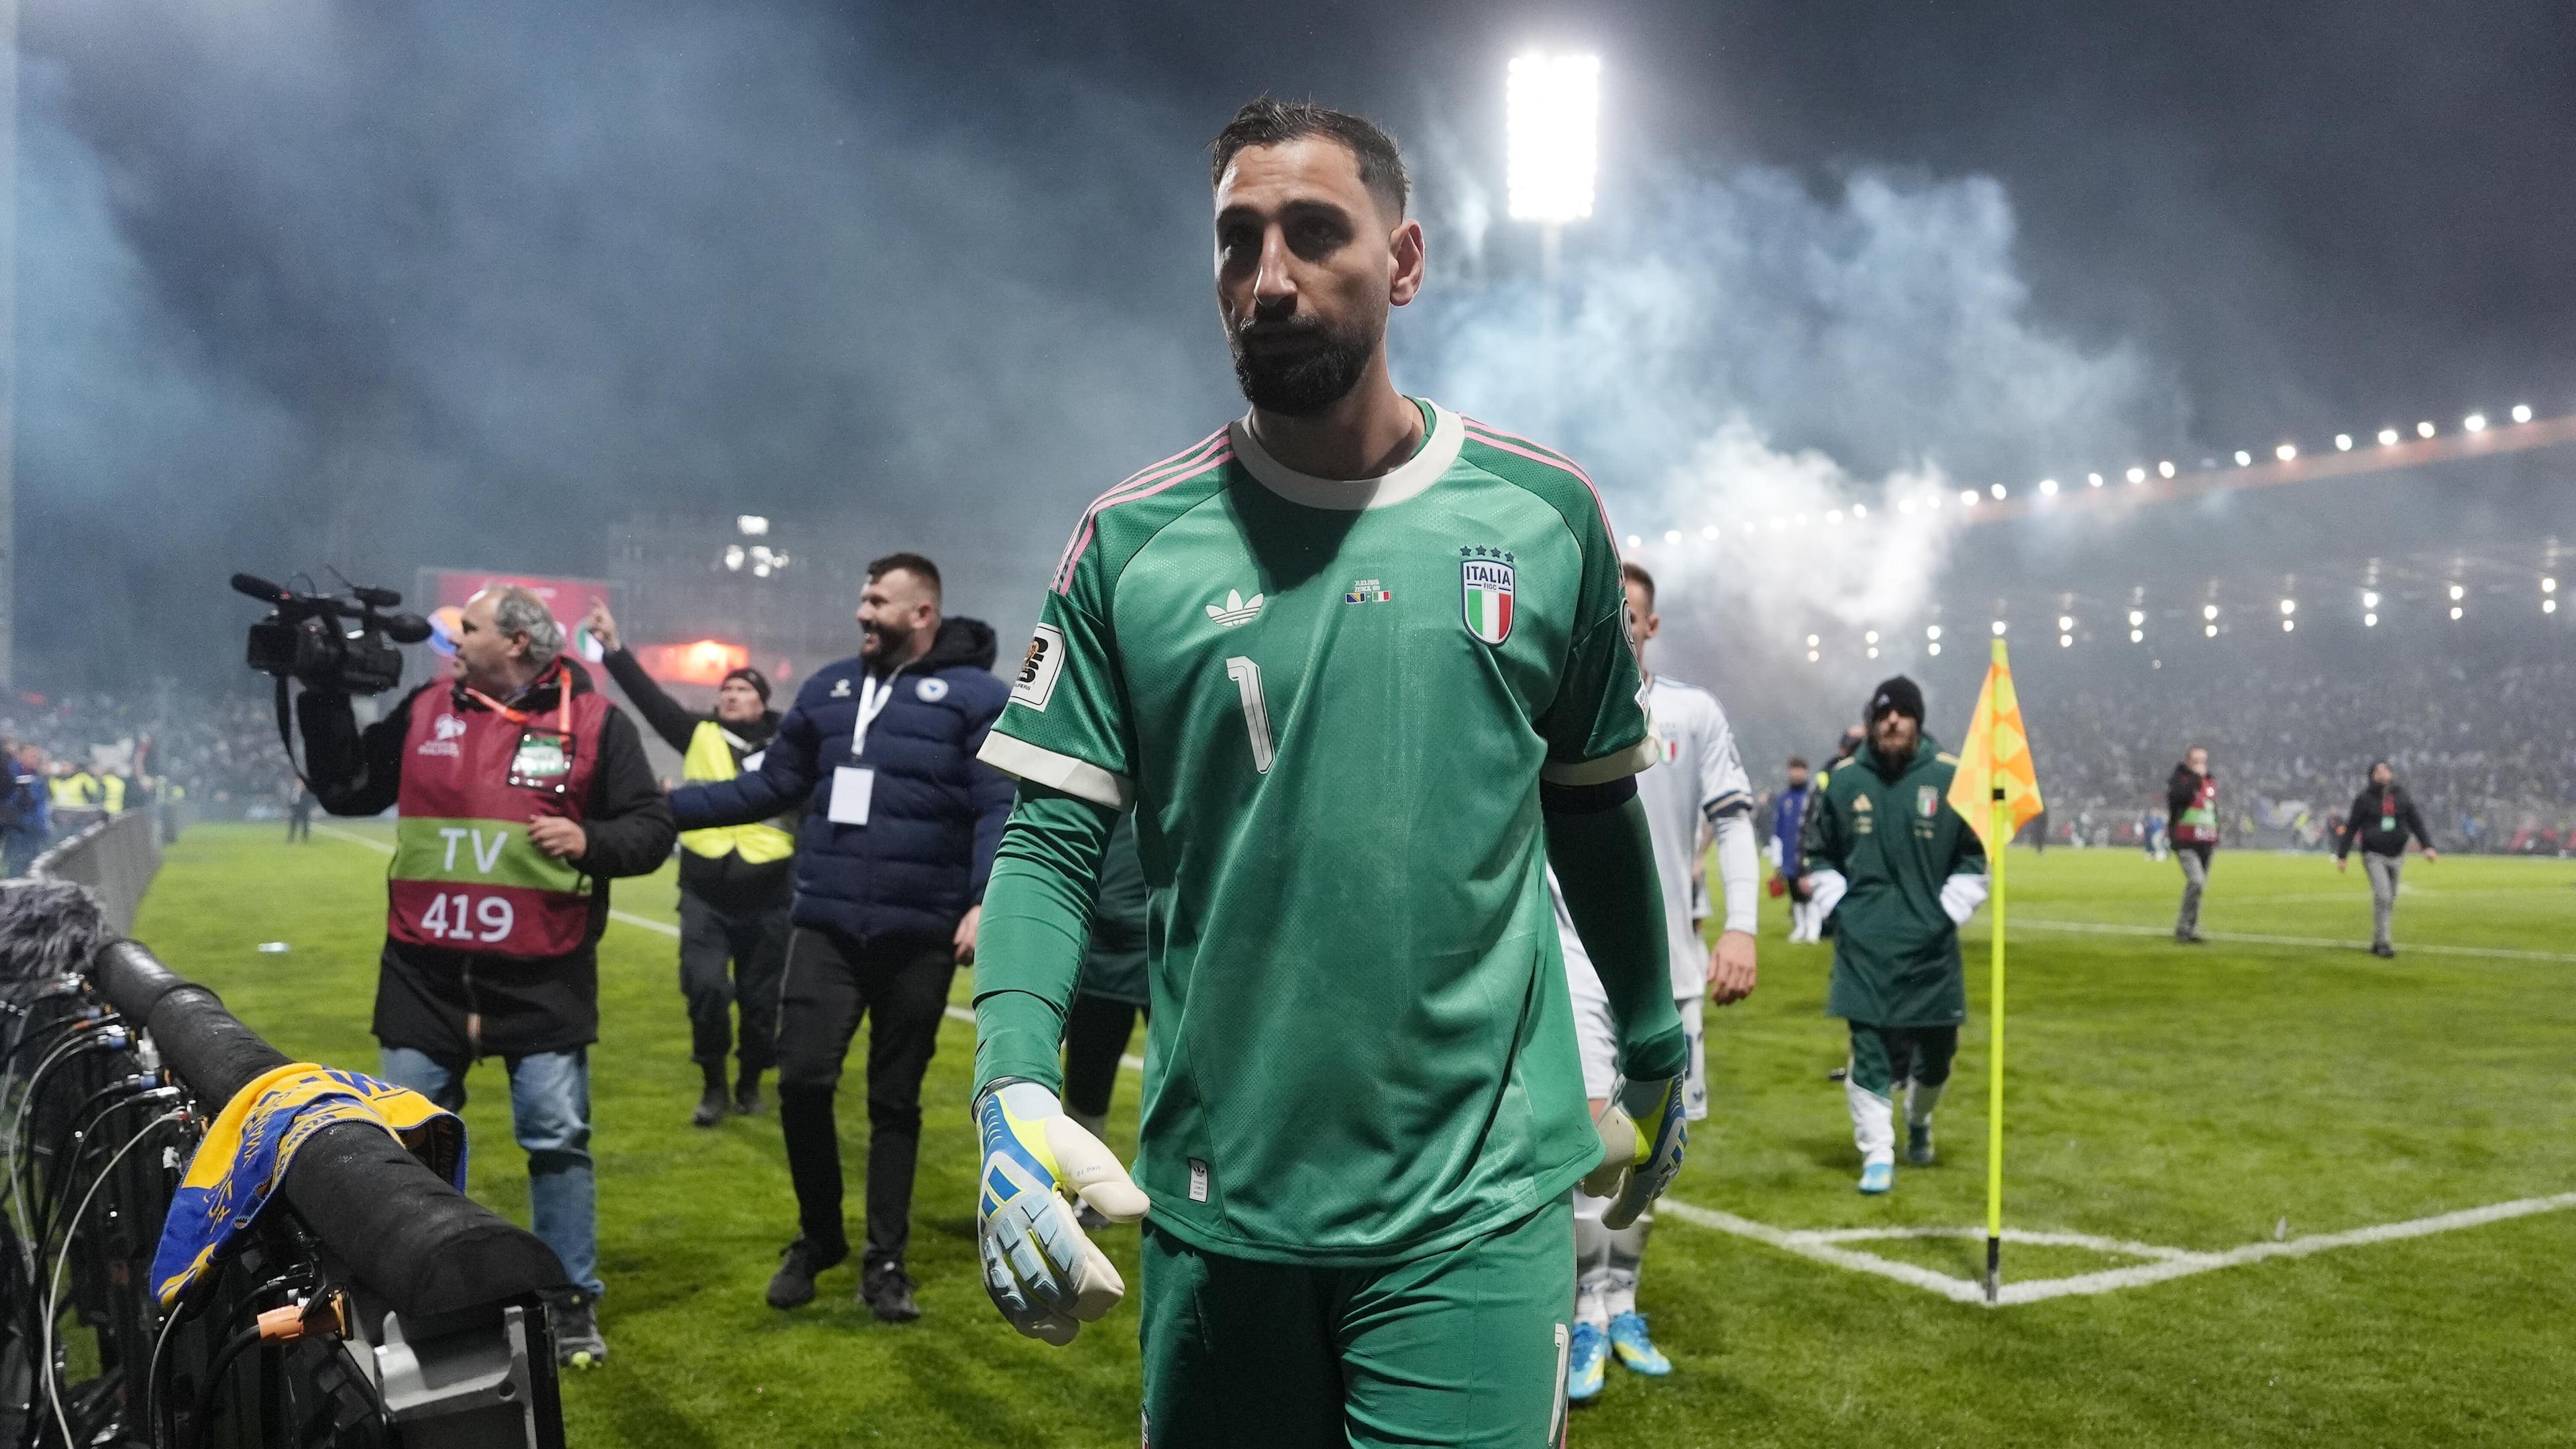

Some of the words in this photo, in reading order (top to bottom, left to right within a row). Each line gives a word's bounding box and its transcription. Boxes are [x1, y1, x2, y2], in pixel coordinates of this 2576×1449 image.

[1466, 566, 1511, 586] ITALIA
[1226, 655, 1275, 774] 1
[439, 828, 508, 872] TV
[421, 894, 514, 941] 419
